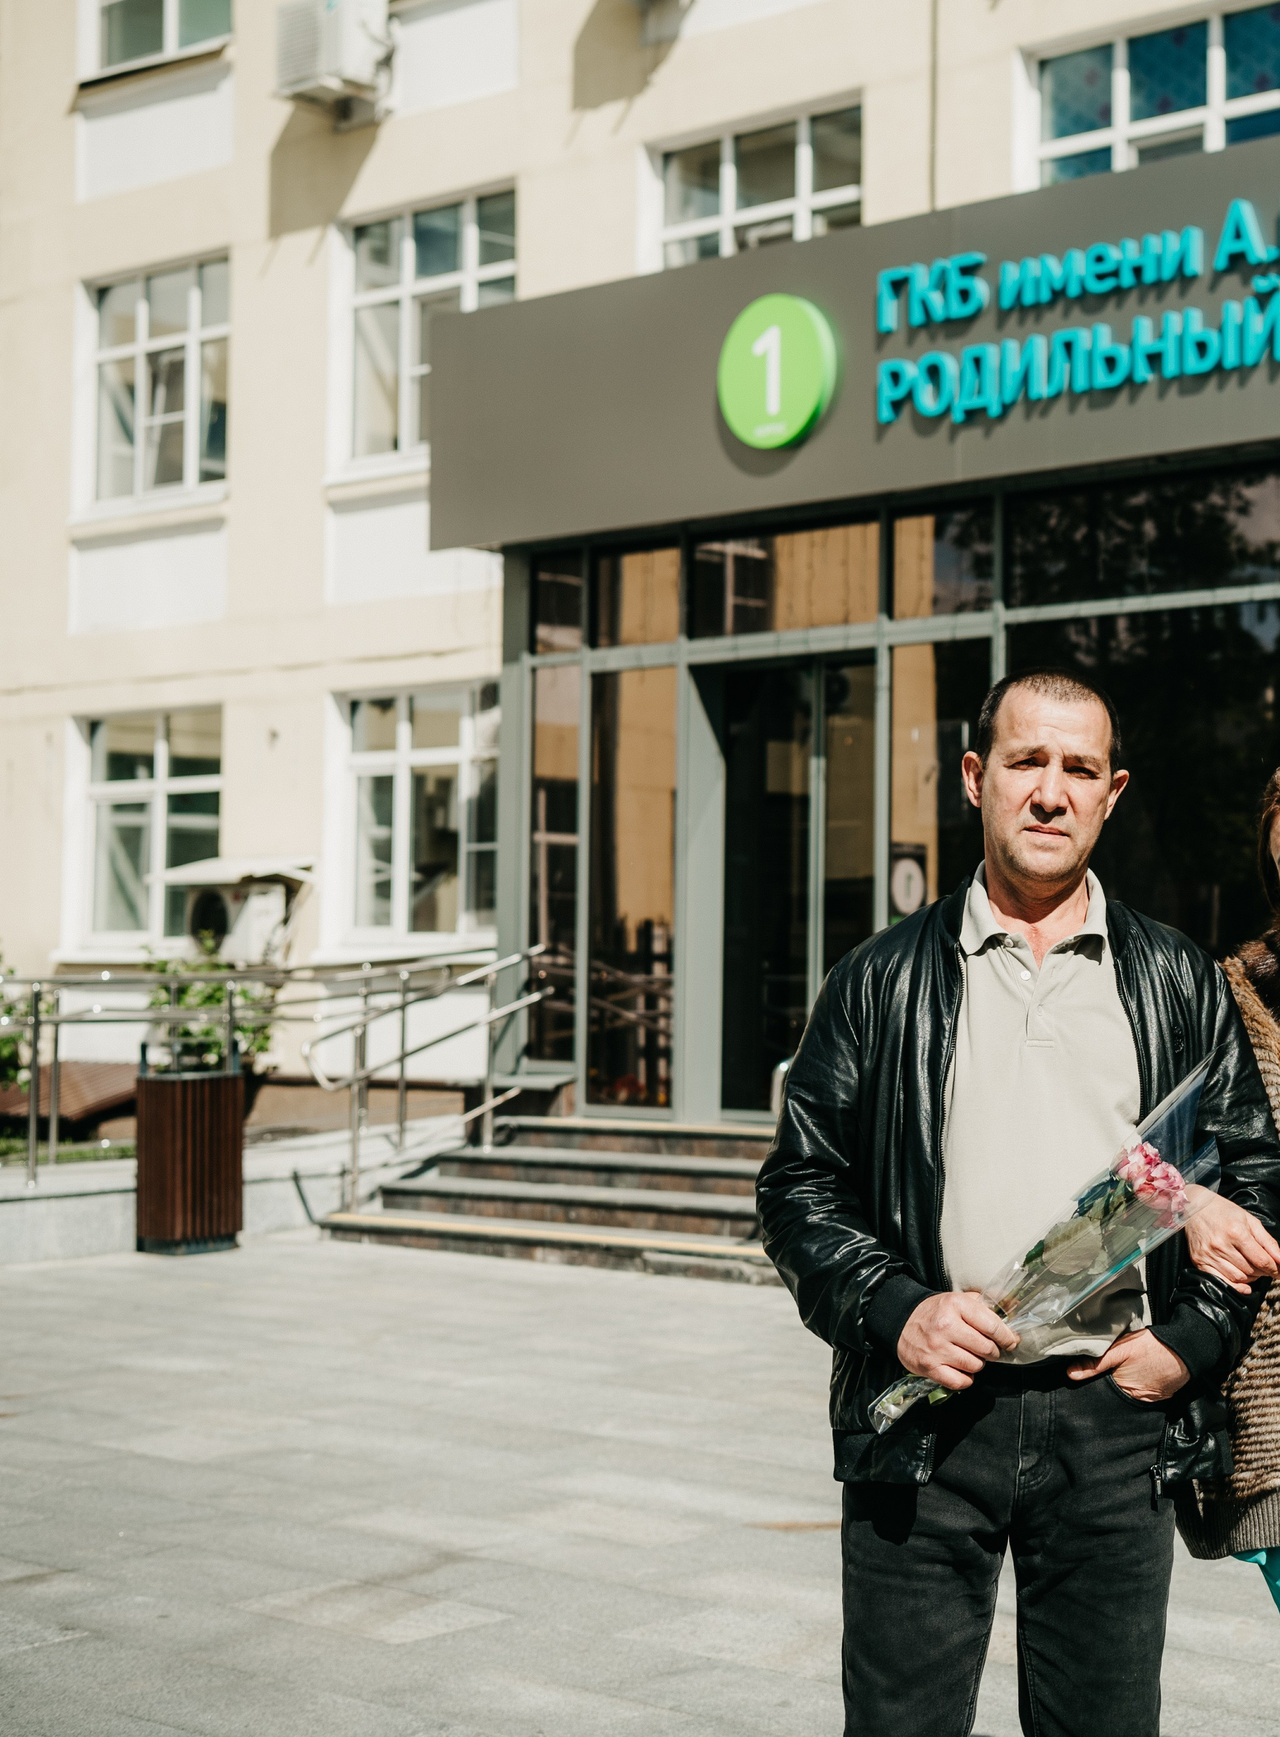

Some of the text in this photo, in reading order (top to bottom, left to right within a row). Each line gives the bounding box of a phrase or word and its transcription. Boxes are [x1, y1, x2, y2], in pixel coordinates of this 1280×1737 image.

[876, 251, 989, 333] ГКБ
[998, 226, 1203, 310] имени
[752, 325, 781, 416] 1
